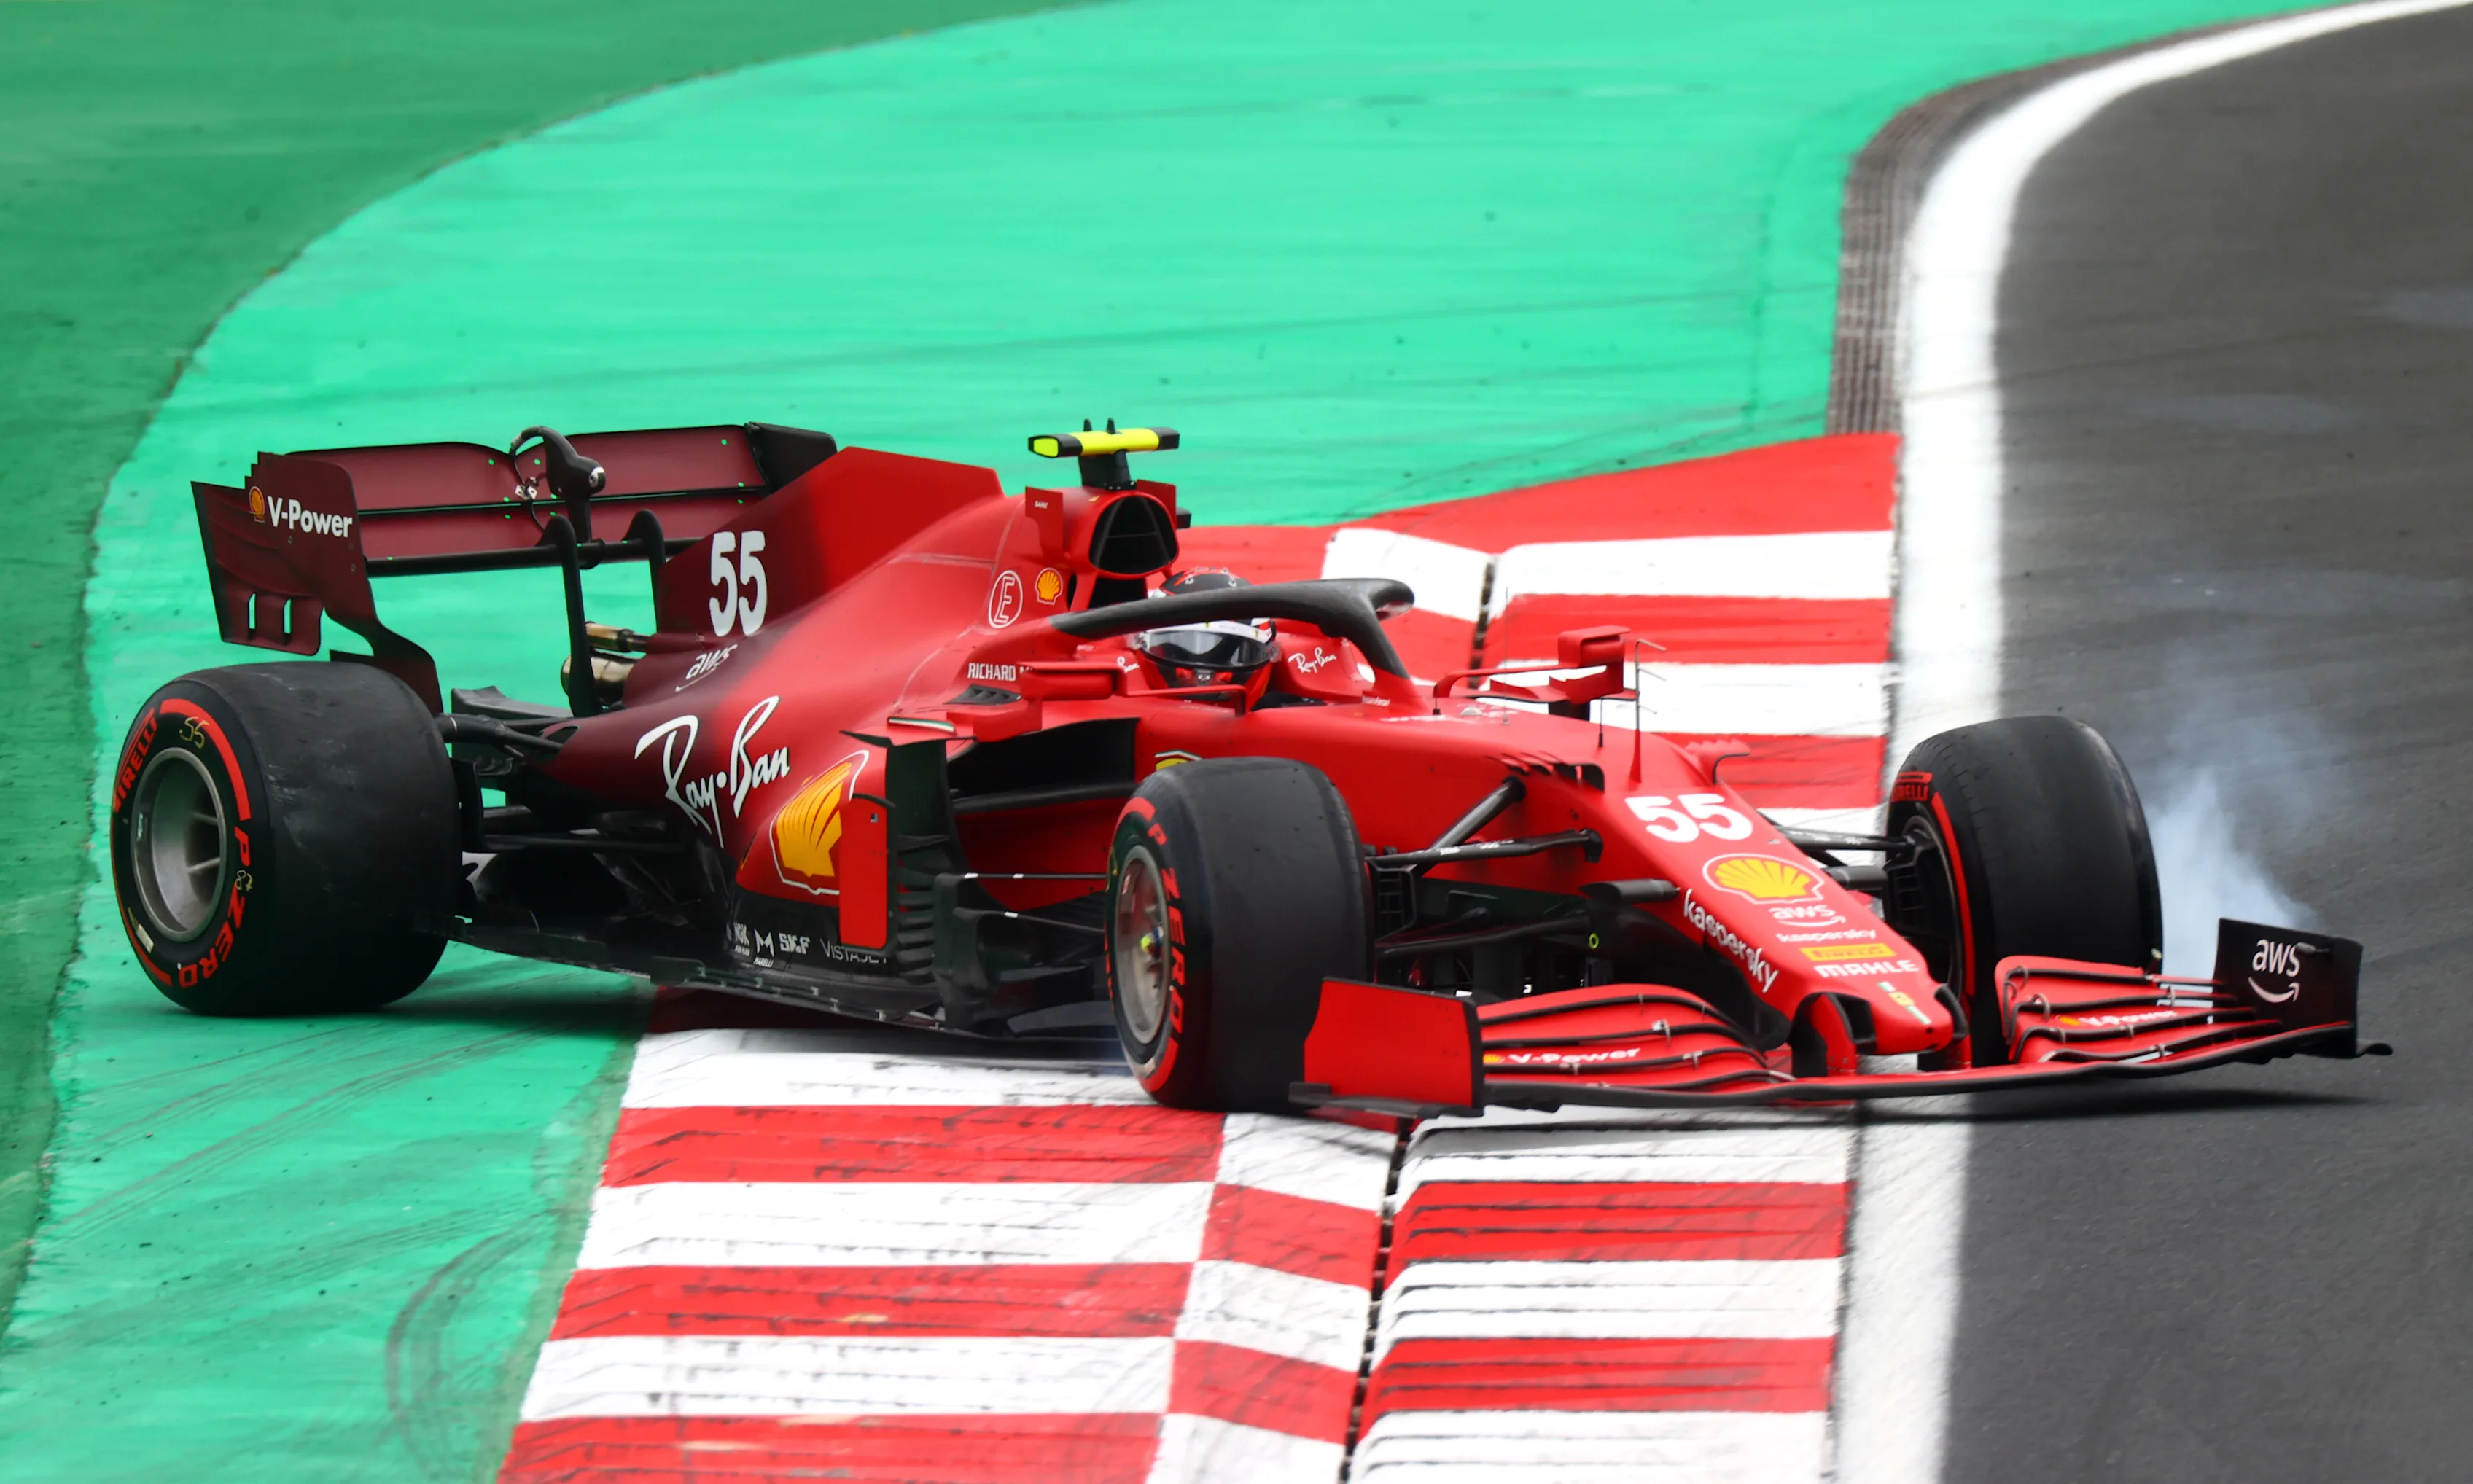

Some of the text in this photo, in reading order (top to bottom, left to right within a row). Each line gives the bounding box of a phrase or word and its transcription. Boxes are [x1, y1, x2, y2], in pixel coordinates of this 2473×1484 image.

[267, 495, 353, 539] V-Power
[709, 531, 767, 637] 55
[685, 644, 739, 680] aws
[967, 662, 1017, 682] RICHARD
[1624, 793, 1754, 843] 55
[1769, 905, 1837, 920] aws
[179, 881, 247, 988] ZERO
[778, 932, 811, 954] SKF
[1161, 867, 1187, 1034] ZERO
[1683, 888, 1779, 993] kaspersky
[1814, 959, 1920, 978] MAHLE
[2251, 938, 2301, 977] aws
[1508, 1047, 1641, 1064] V-Power
